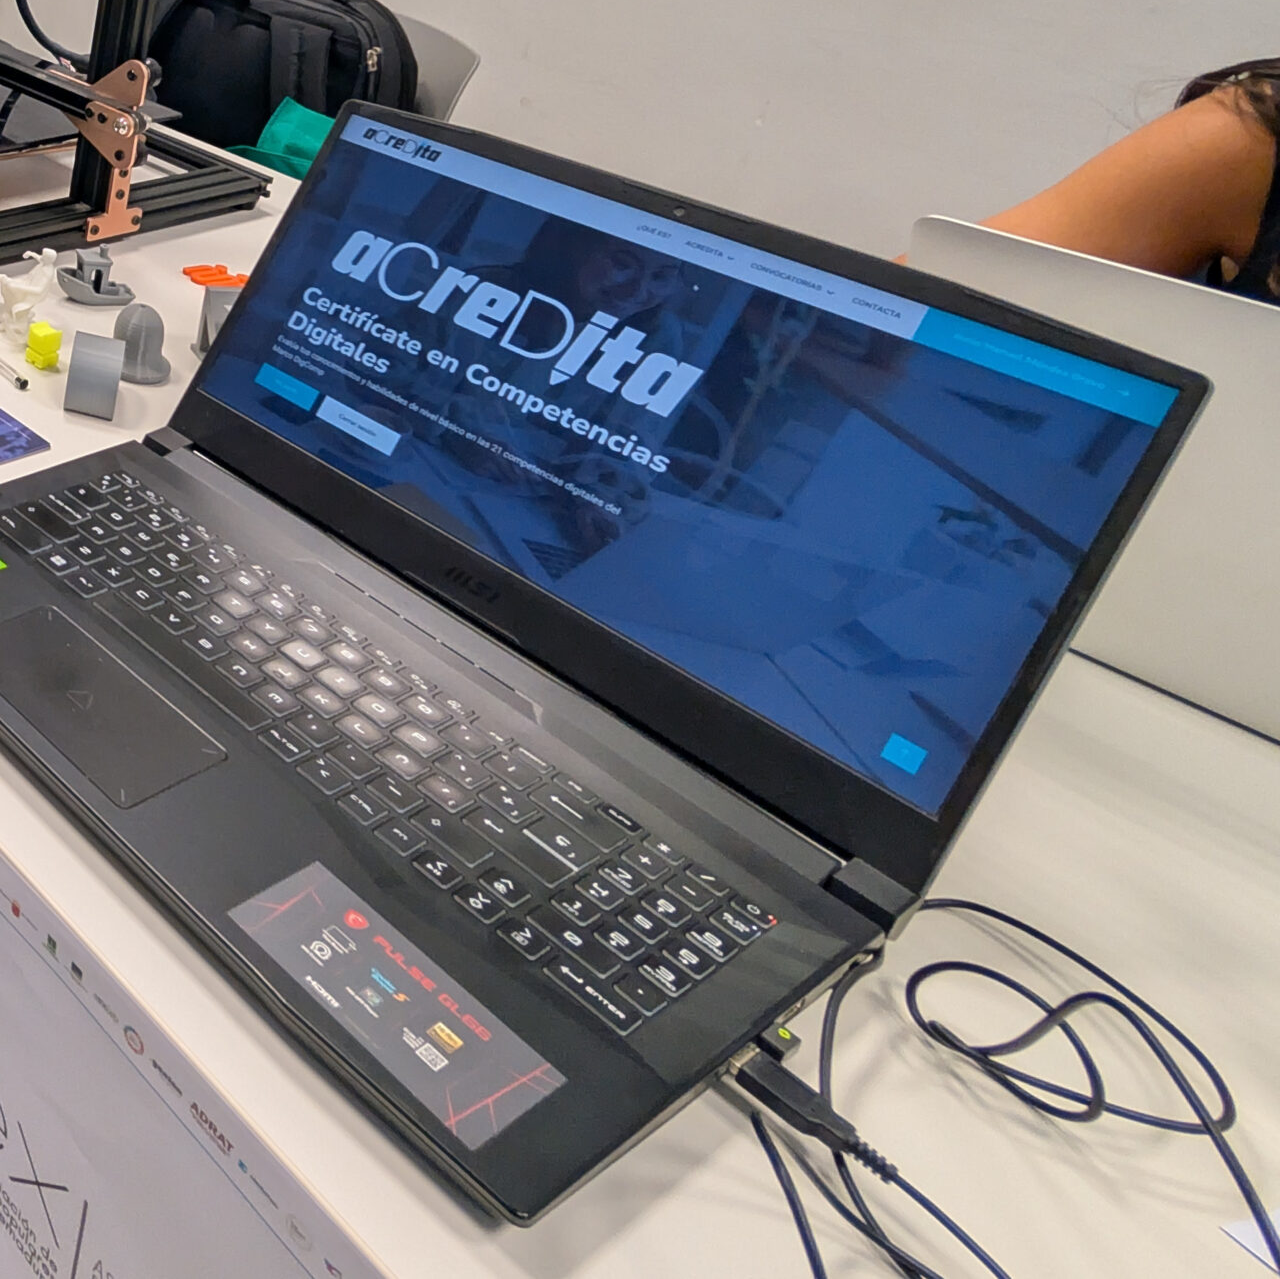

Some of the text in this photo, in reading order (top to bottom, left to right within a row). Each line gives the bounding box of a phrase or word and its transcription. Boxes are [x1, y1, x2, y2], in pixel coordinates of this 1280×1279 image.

[685, 240, 723, 257] ACREDITA
[750, 262, 822, 292] CONVOCATORIAS
[851, 297, 901, 319] CONTACTA
[286, 309, 392, 376] Digitales
[301, 285, 672, 476] Certifícate en Competencias
[311, 351, 361, 382] conocimientos
[366, 379, 409, 408] habilidades
[408, 401, 420, 413] de
[419, 407, 440, 423] nivel
[438, 414, 465, 436] básico
[465, 432, 477, 442] en
[477, 436, 491, 449] las
[490, 444, 503, 455] 21
[503, 451, 565, 487] competencias
[564, 482, 604, 509] digitales
[604, 502, 622, 516] del
[373, 935, 438, 992] PULSE
[437, 993, 492, 1042] GL66
[584, 985, 626, 1019] ENTER
[190, 1101, 235, 1154] ADRAT
[40, 1246, 58, 1273] de
